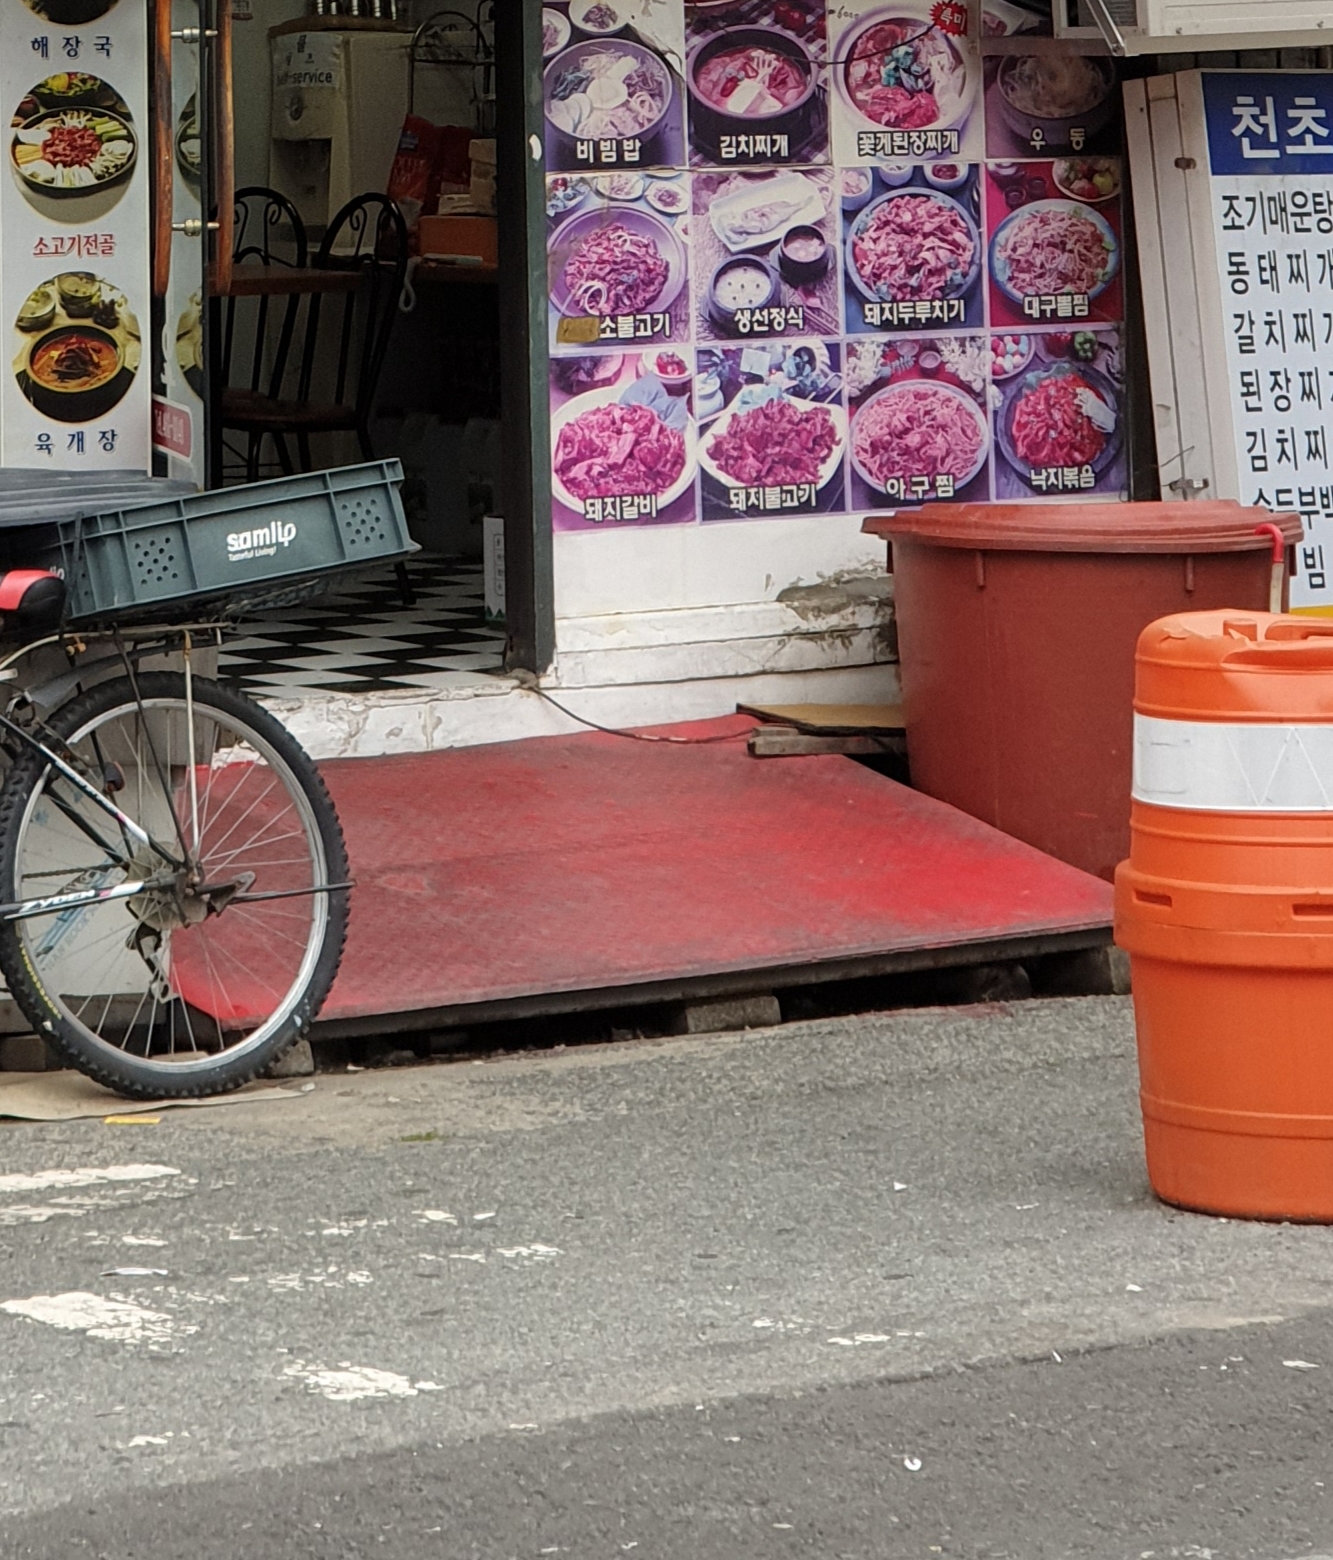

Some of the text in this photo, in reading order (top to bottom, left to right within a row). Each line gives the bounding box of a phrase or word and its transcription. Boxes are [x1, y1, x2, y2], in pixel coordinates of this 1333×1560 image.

[30, 35, 114, 59] 해장국
[576, 137, 643, 163] 비빔밥
[719, 133, 790, 159] 김치찌개
[858, 129, 960, 157] 꽃게된장찌개
[1221, 189, 1333, 236] 조기매운탕
[32, 233, 116, 258] 소고기전골
[733, 306, 805, 333] 생선정식
[863, 298, 966, 326] 돼지두루치기
[599, 313, 671, 339] 소불고기
[1239, 366, 1333, 413] 된장찌
[34, 428, 118, 455] 육개장
[885, 473, 955, 501] 아구찜
[1029, 464, 1096, 491] 낙지볶음
[584, 493, 659, 522] 돼지갈비
[728, 484, 818, 511] 돼지불고기
[18, 889, 96, 915] ZYDEN
